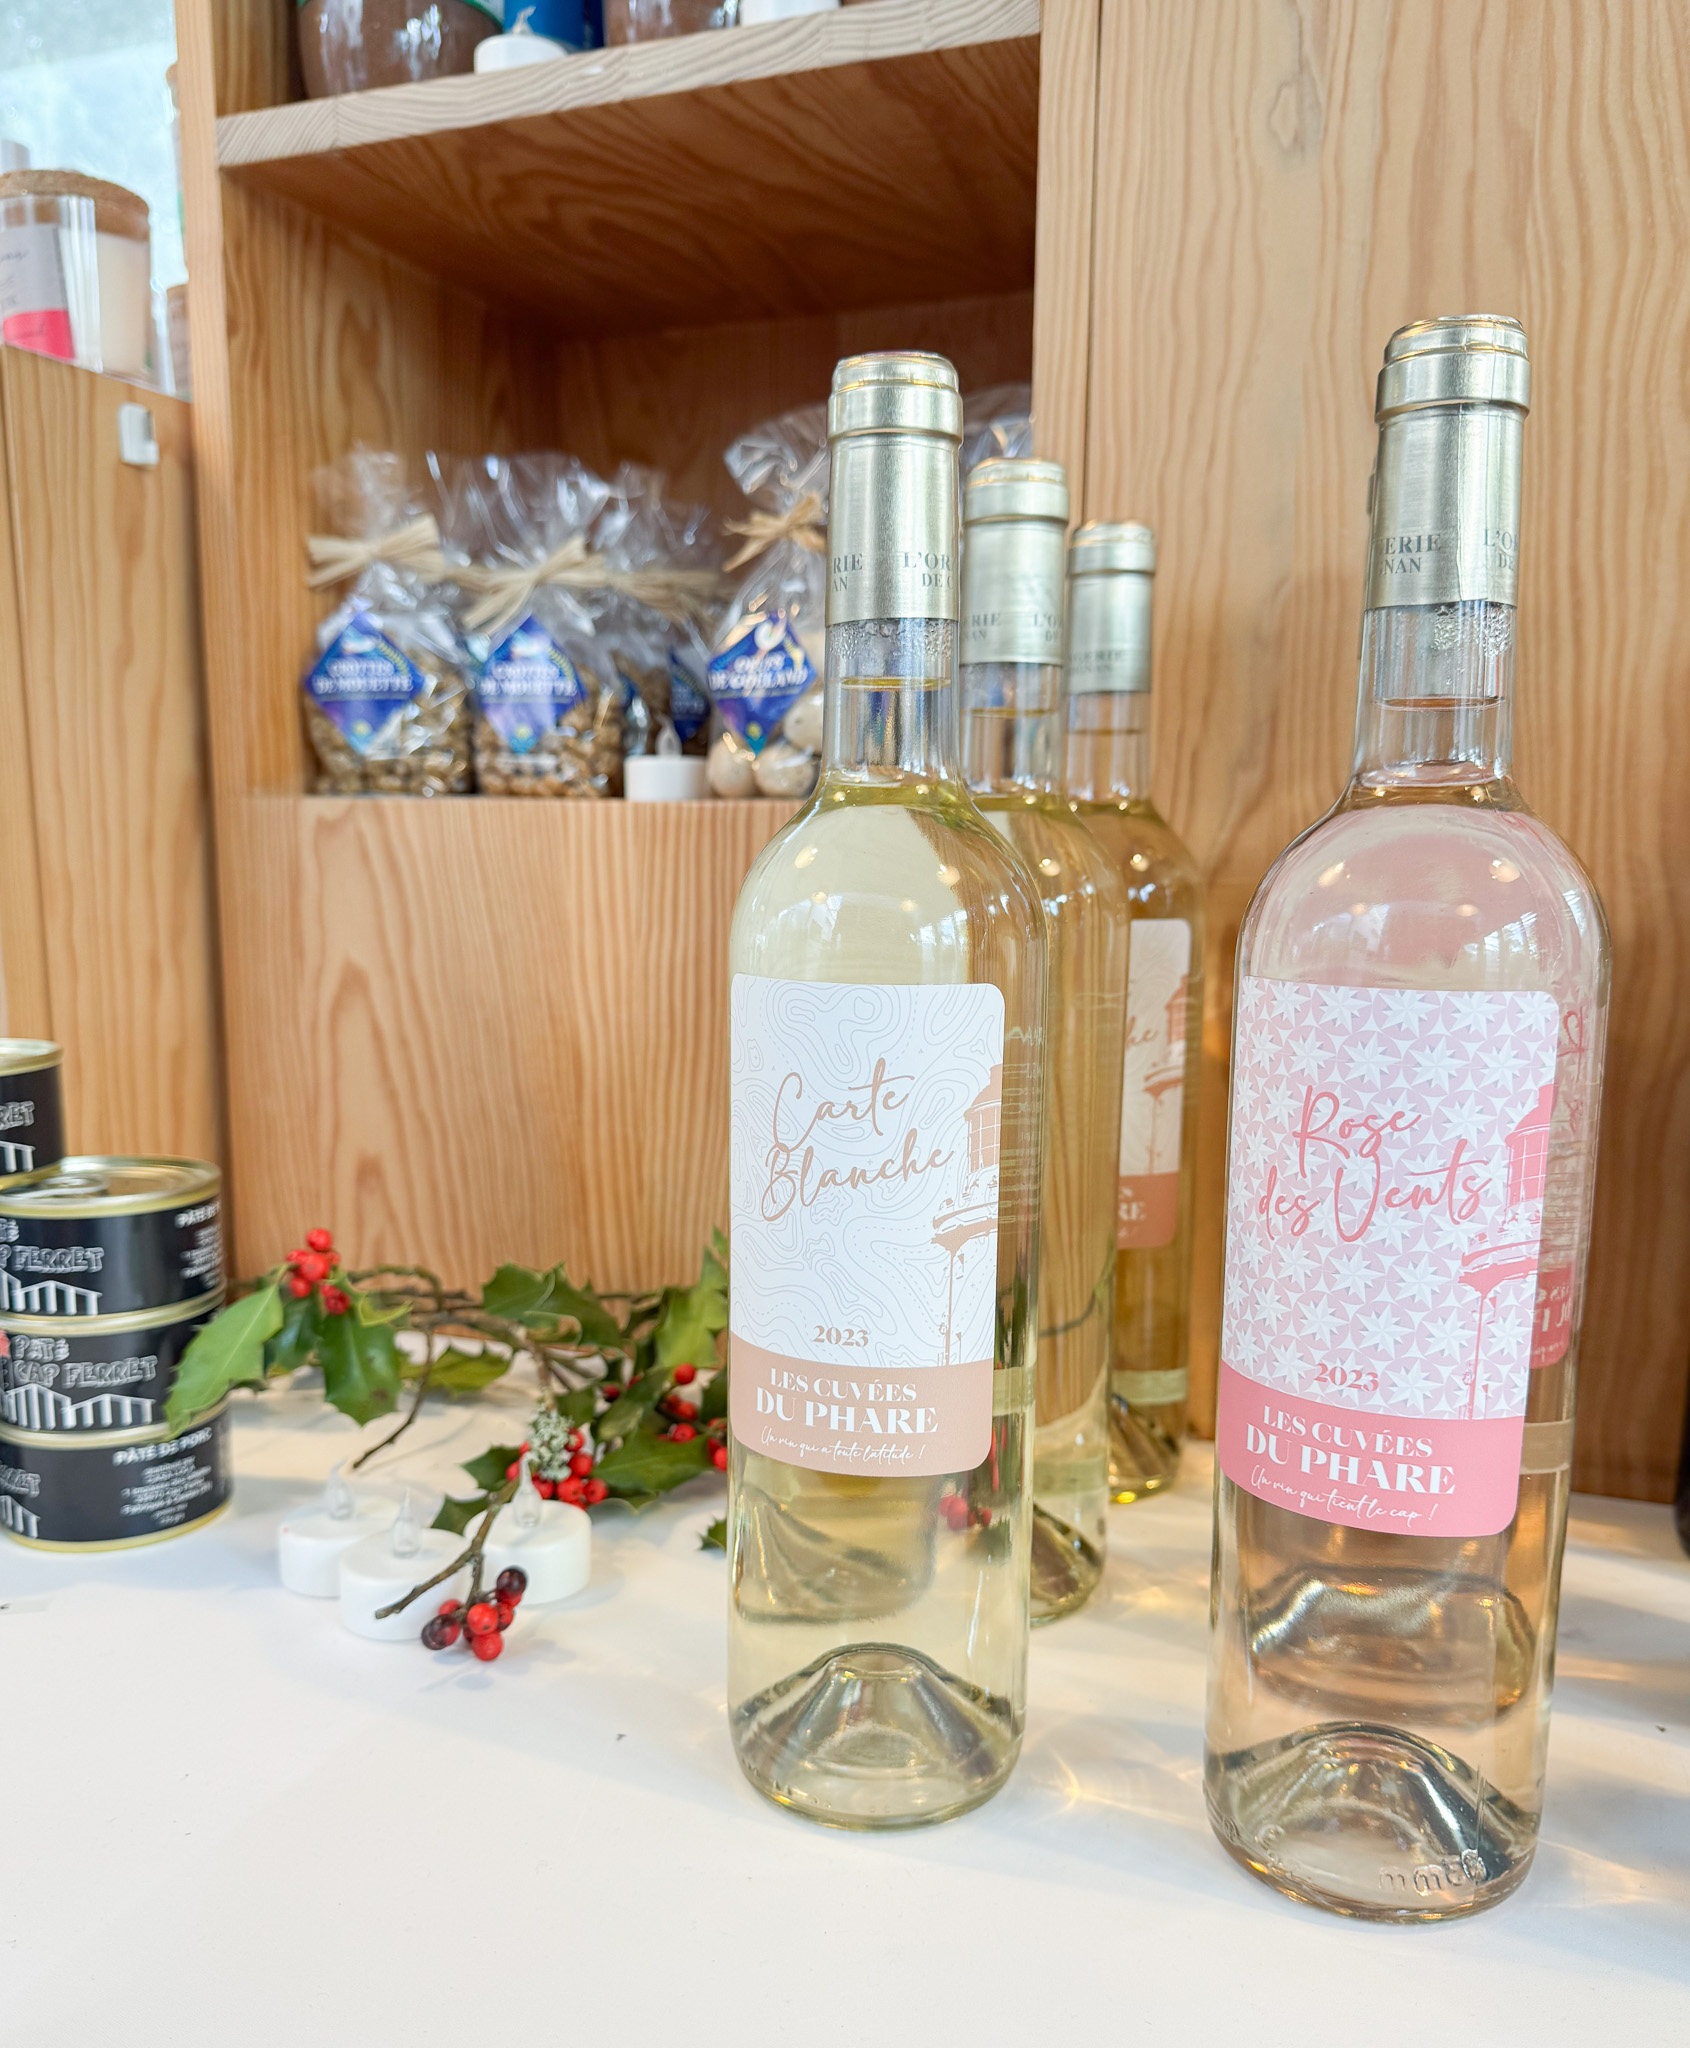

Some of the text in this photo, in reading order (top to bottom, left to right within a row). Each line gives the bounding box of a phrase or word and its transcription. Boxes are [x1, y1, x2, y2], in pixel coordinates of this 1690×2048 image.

[922, 573, 943, 587] DE
[773, 1057, 915, 1152] Carte
[1292, 1085, 1421, 1178] Rose
[762, 1127, 954, 1221] Blanche
[1258, 1138, 1492, 1242] des Vents
[12, 1246, 104, 1273] FERRET
[812, 1325, 869, 1347] 2023
[13, 1355, 158, 1389] CAP FERRET
[770, 1368, 917, 1402] LES CUVÉES
[1313, 1363, 1379, 1392] 2023
[756, 1387, 939, 1434] DU PHARE
[1263, 1405, 1432, 1457] LES CUVÉES
[761, 1425, 778, 1444] Un
[779, 1438, 798, 1448] vin
[800, 1443, 819, 1457] qui
[830, 1440, 862, 1462] toute
[863, 1443, 913, 1465] latitude
[1246, 1423, 1455, 1494] DU PHARE
[1251, 1465, 1271, 1489] Un
[1273, 1481, 1298, 1495] vin
[1300, 1488, 1324, 1508] qui
[1322, 1489, 1367, 1518] tient
[1367, 1498, 1387, 1518] le
[1387, 1507, 1422, 1528] cap
